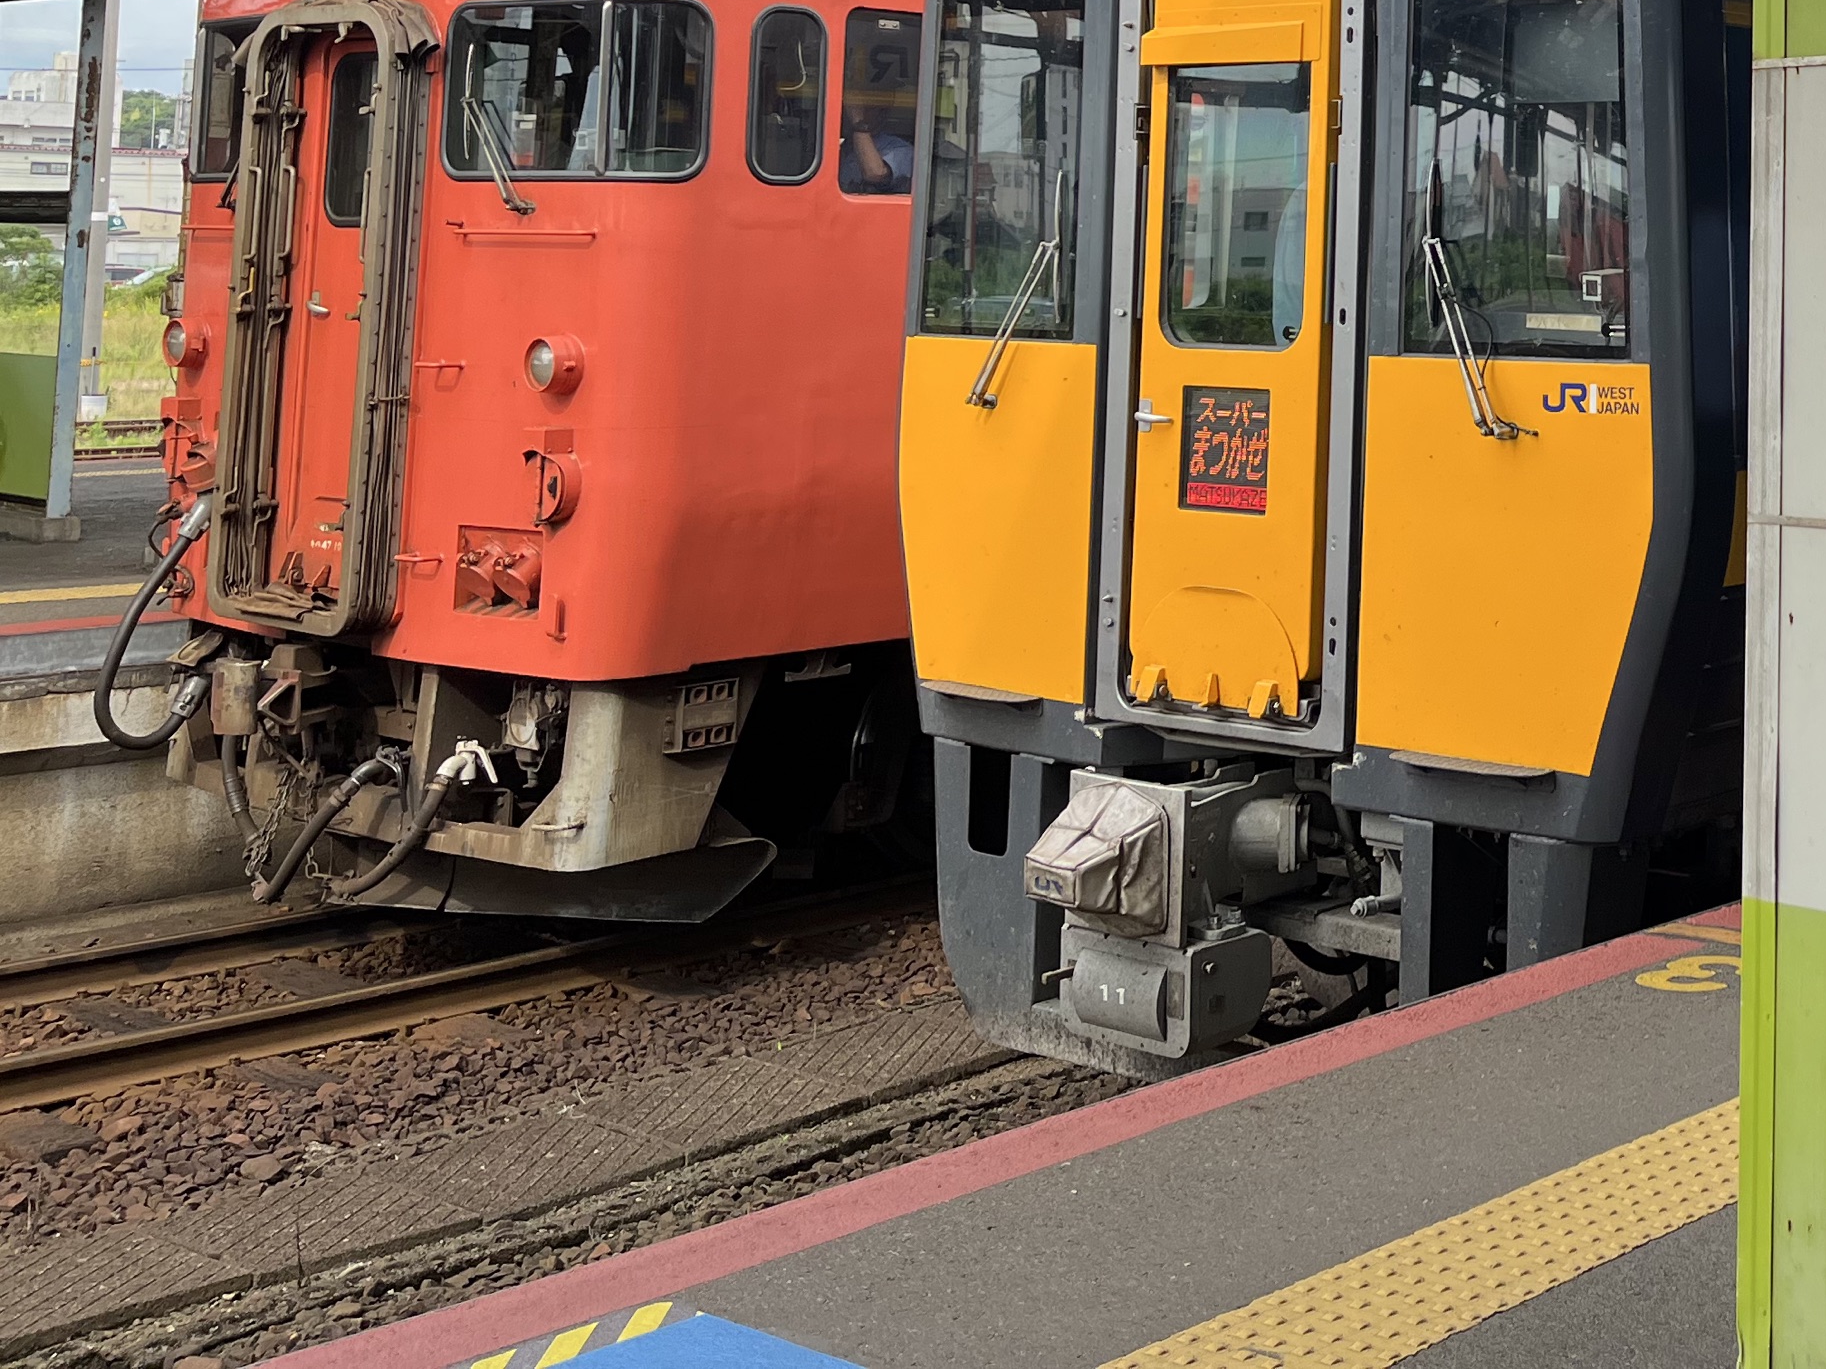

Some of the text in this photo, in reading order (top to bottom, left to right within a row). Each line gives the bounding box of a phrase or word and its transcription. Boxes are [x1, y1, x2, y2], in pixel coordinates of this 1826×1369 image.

[1543, 383, 1587, 413] JR
[1597, 387, 1634, 400] WEST
[1196, 397, 1267, 427] スーパー
[1597, 401, 1640, 415] JAPAN
[1189, 426, 1269, 480] まつかぜ
[1188, 483, 1267, 508] MATSUKAZE
[1099, 984, 1126, 1005] 11
